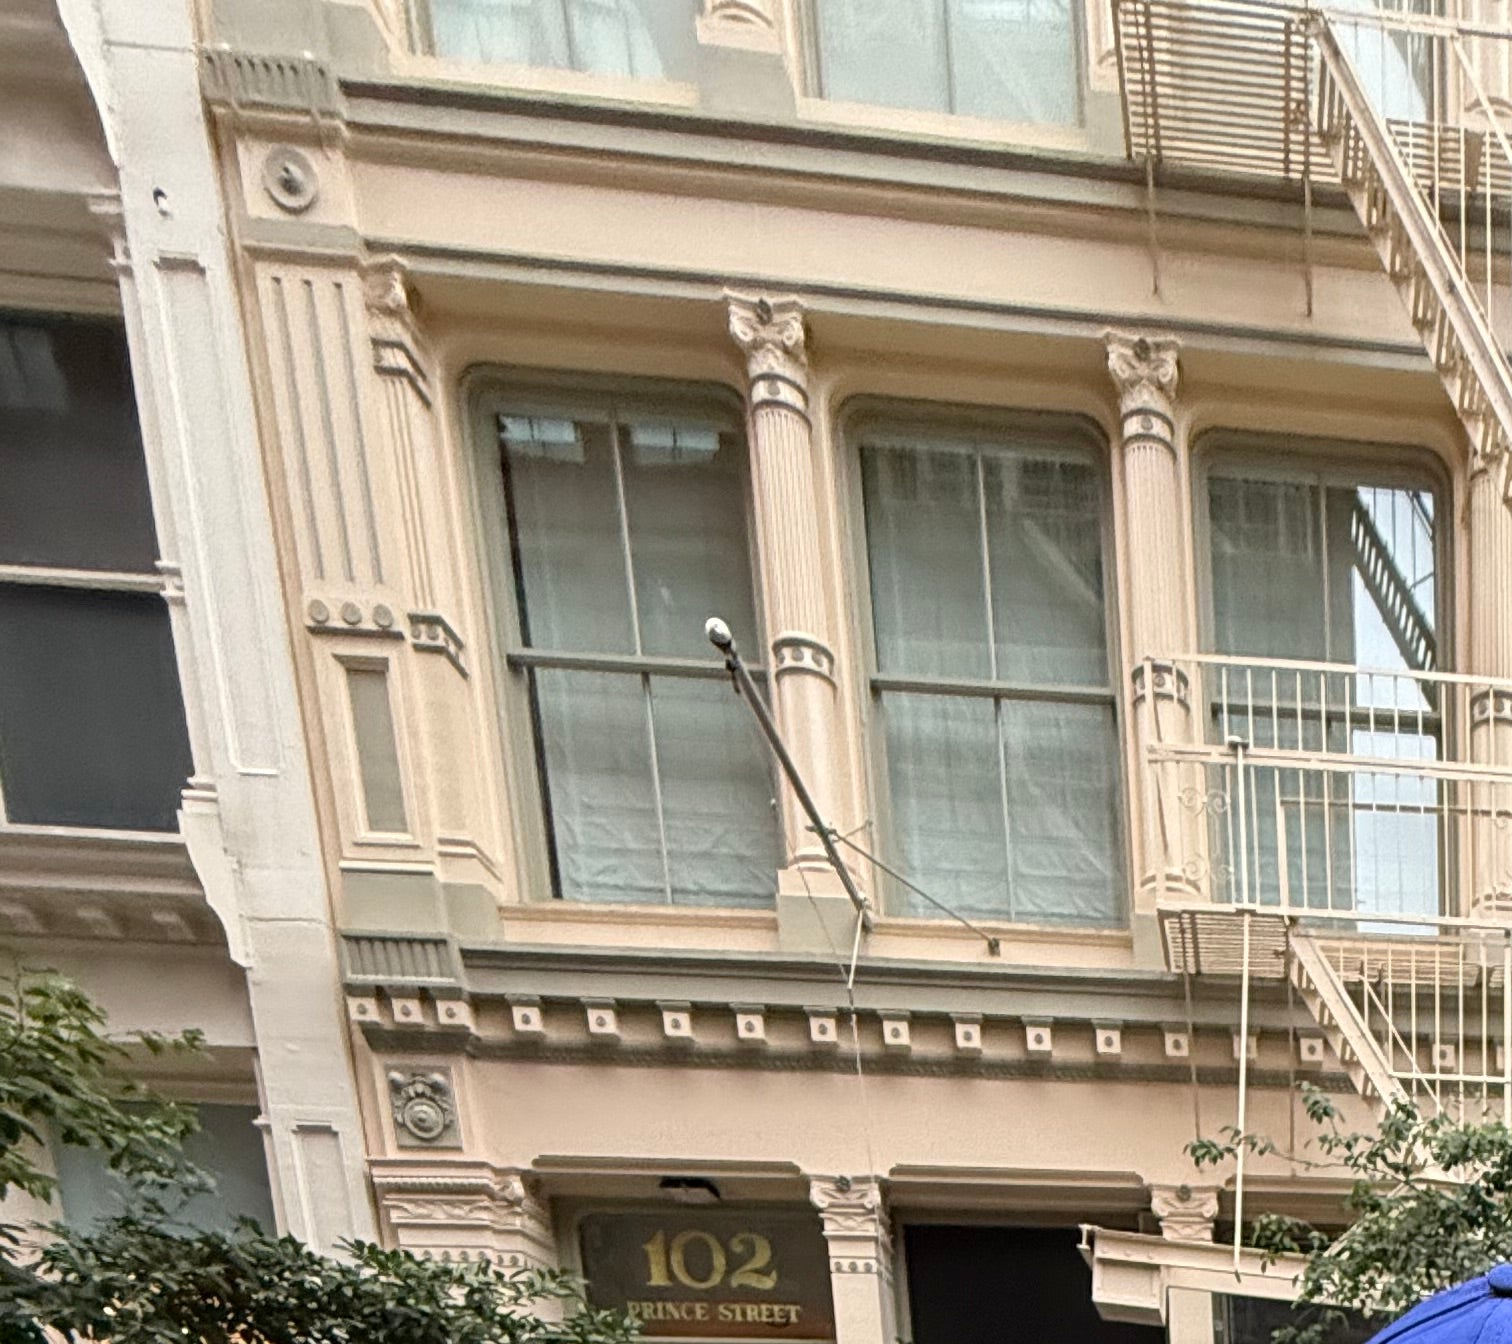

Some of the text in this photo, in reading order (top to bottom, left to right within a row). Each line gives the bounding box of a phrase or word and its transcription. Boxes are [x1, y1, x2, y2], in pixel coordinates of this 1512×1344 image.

[642, 1229, 778, 1290] 102
[627, 1300, 801, 1323] PRINCE STREET
